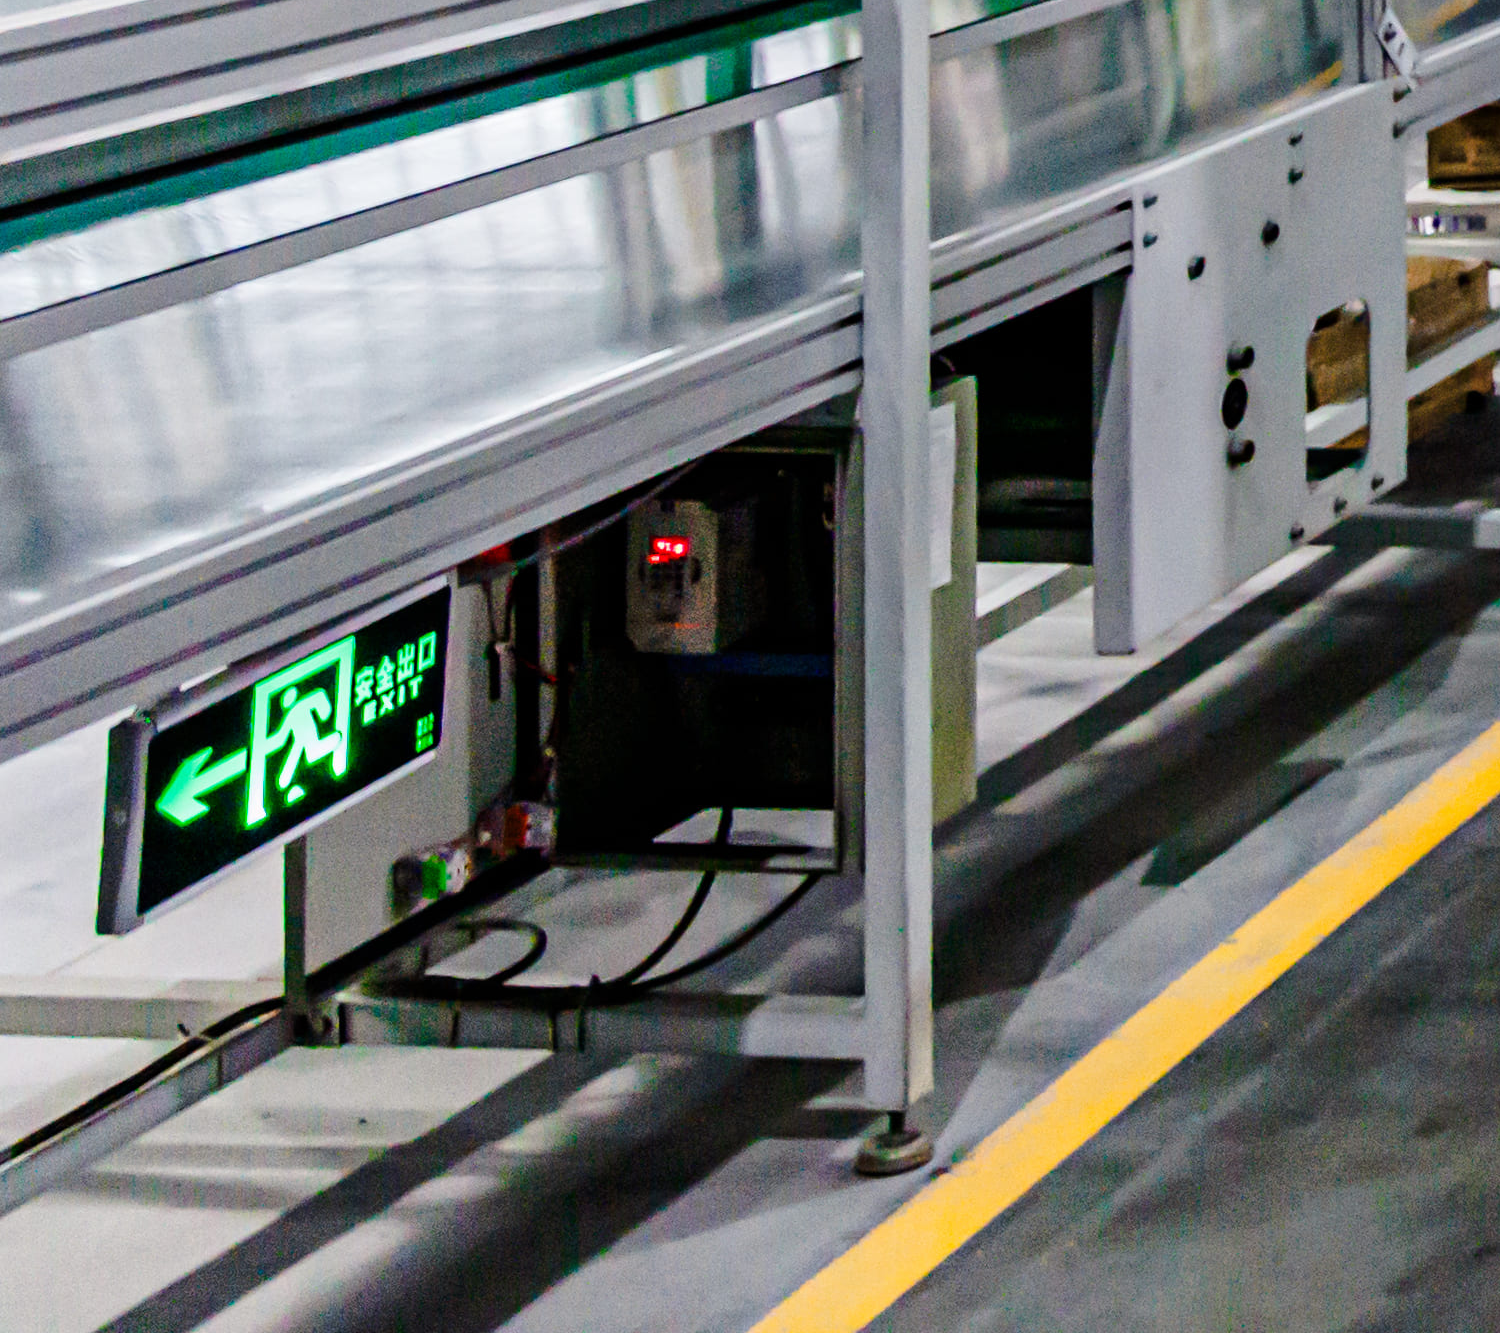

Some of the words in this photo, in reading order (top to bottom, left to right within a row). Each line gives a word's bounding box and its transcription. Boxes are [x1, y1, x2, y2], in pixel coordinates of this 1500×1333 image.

[354, 631, 437, 708] 安全出口
[361, 674, 423, 727] EXIT
